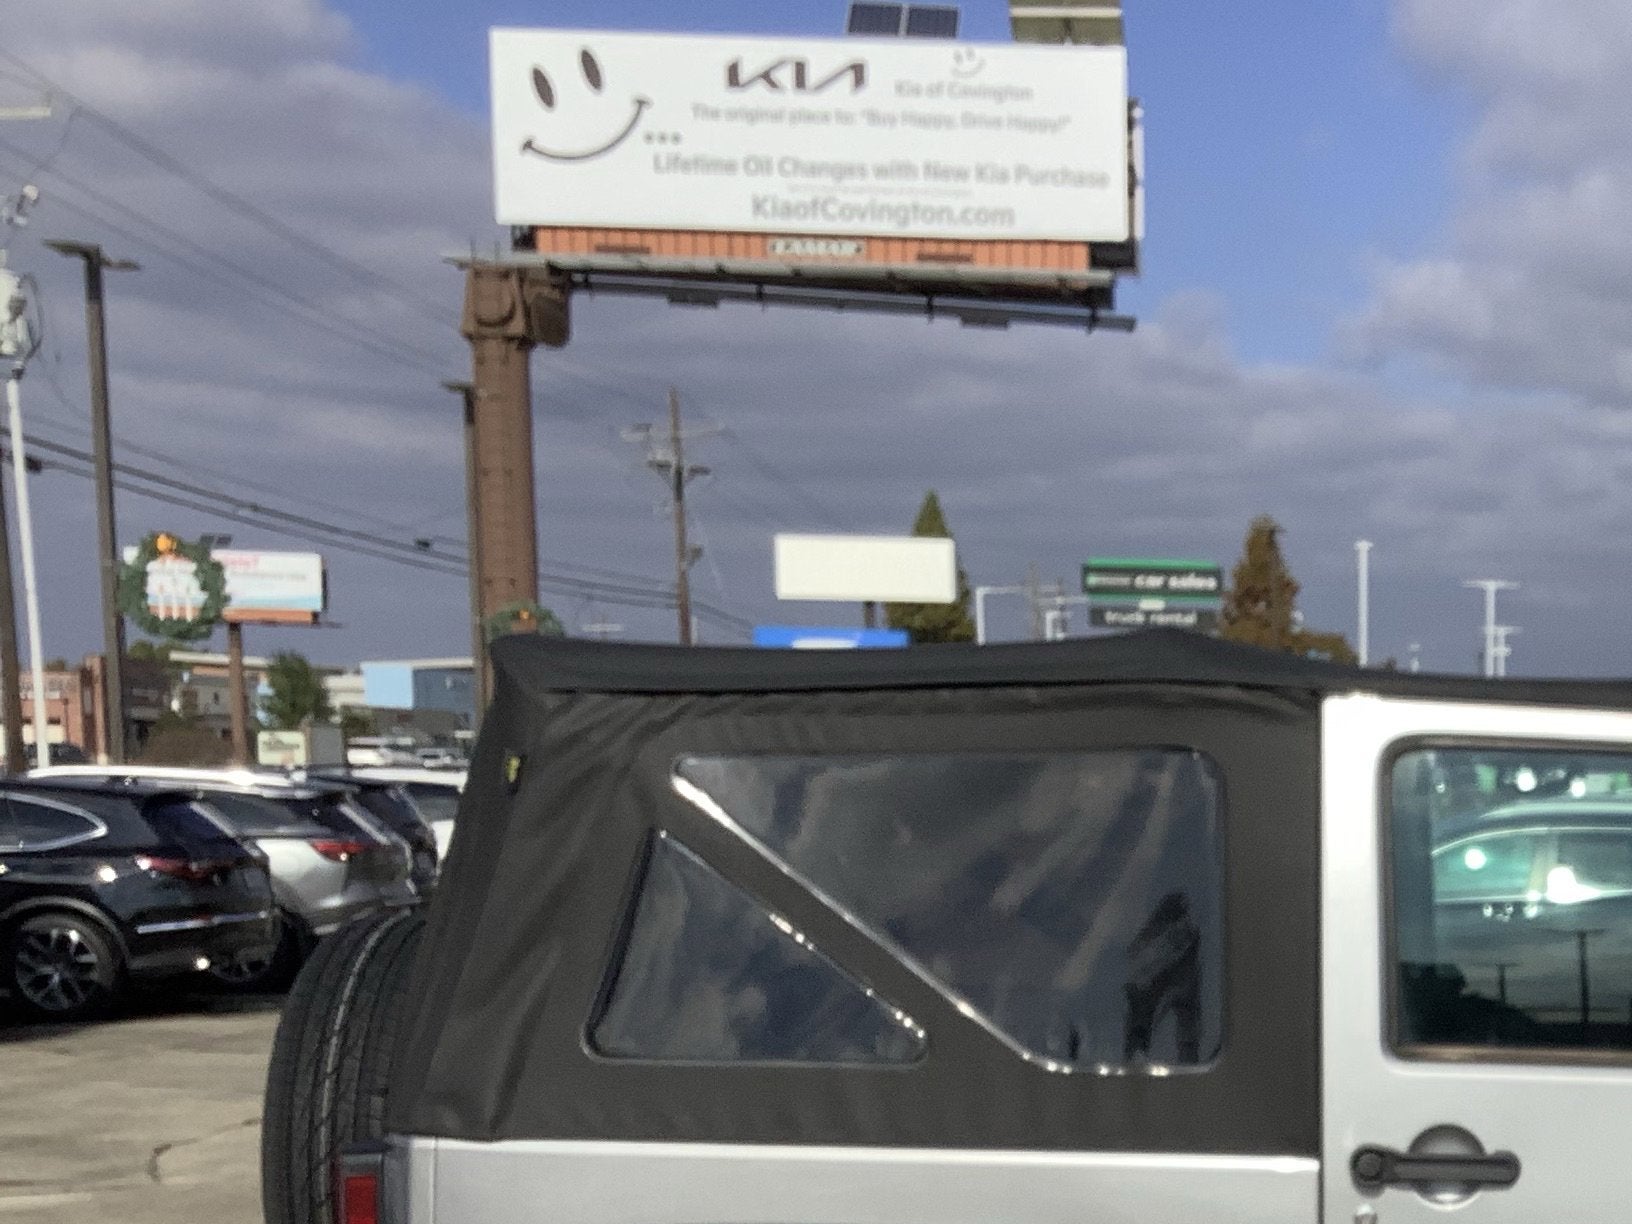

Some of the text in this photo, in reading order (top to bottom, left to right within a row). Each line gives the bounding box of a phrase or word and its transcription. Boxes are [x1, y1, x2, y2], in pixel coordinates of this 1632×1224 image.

[652, 152, 1111, 188] Lifetime Oil Changes with New Kia Purchase
[750, 195, 1016, 228] KiaofCovington.com
